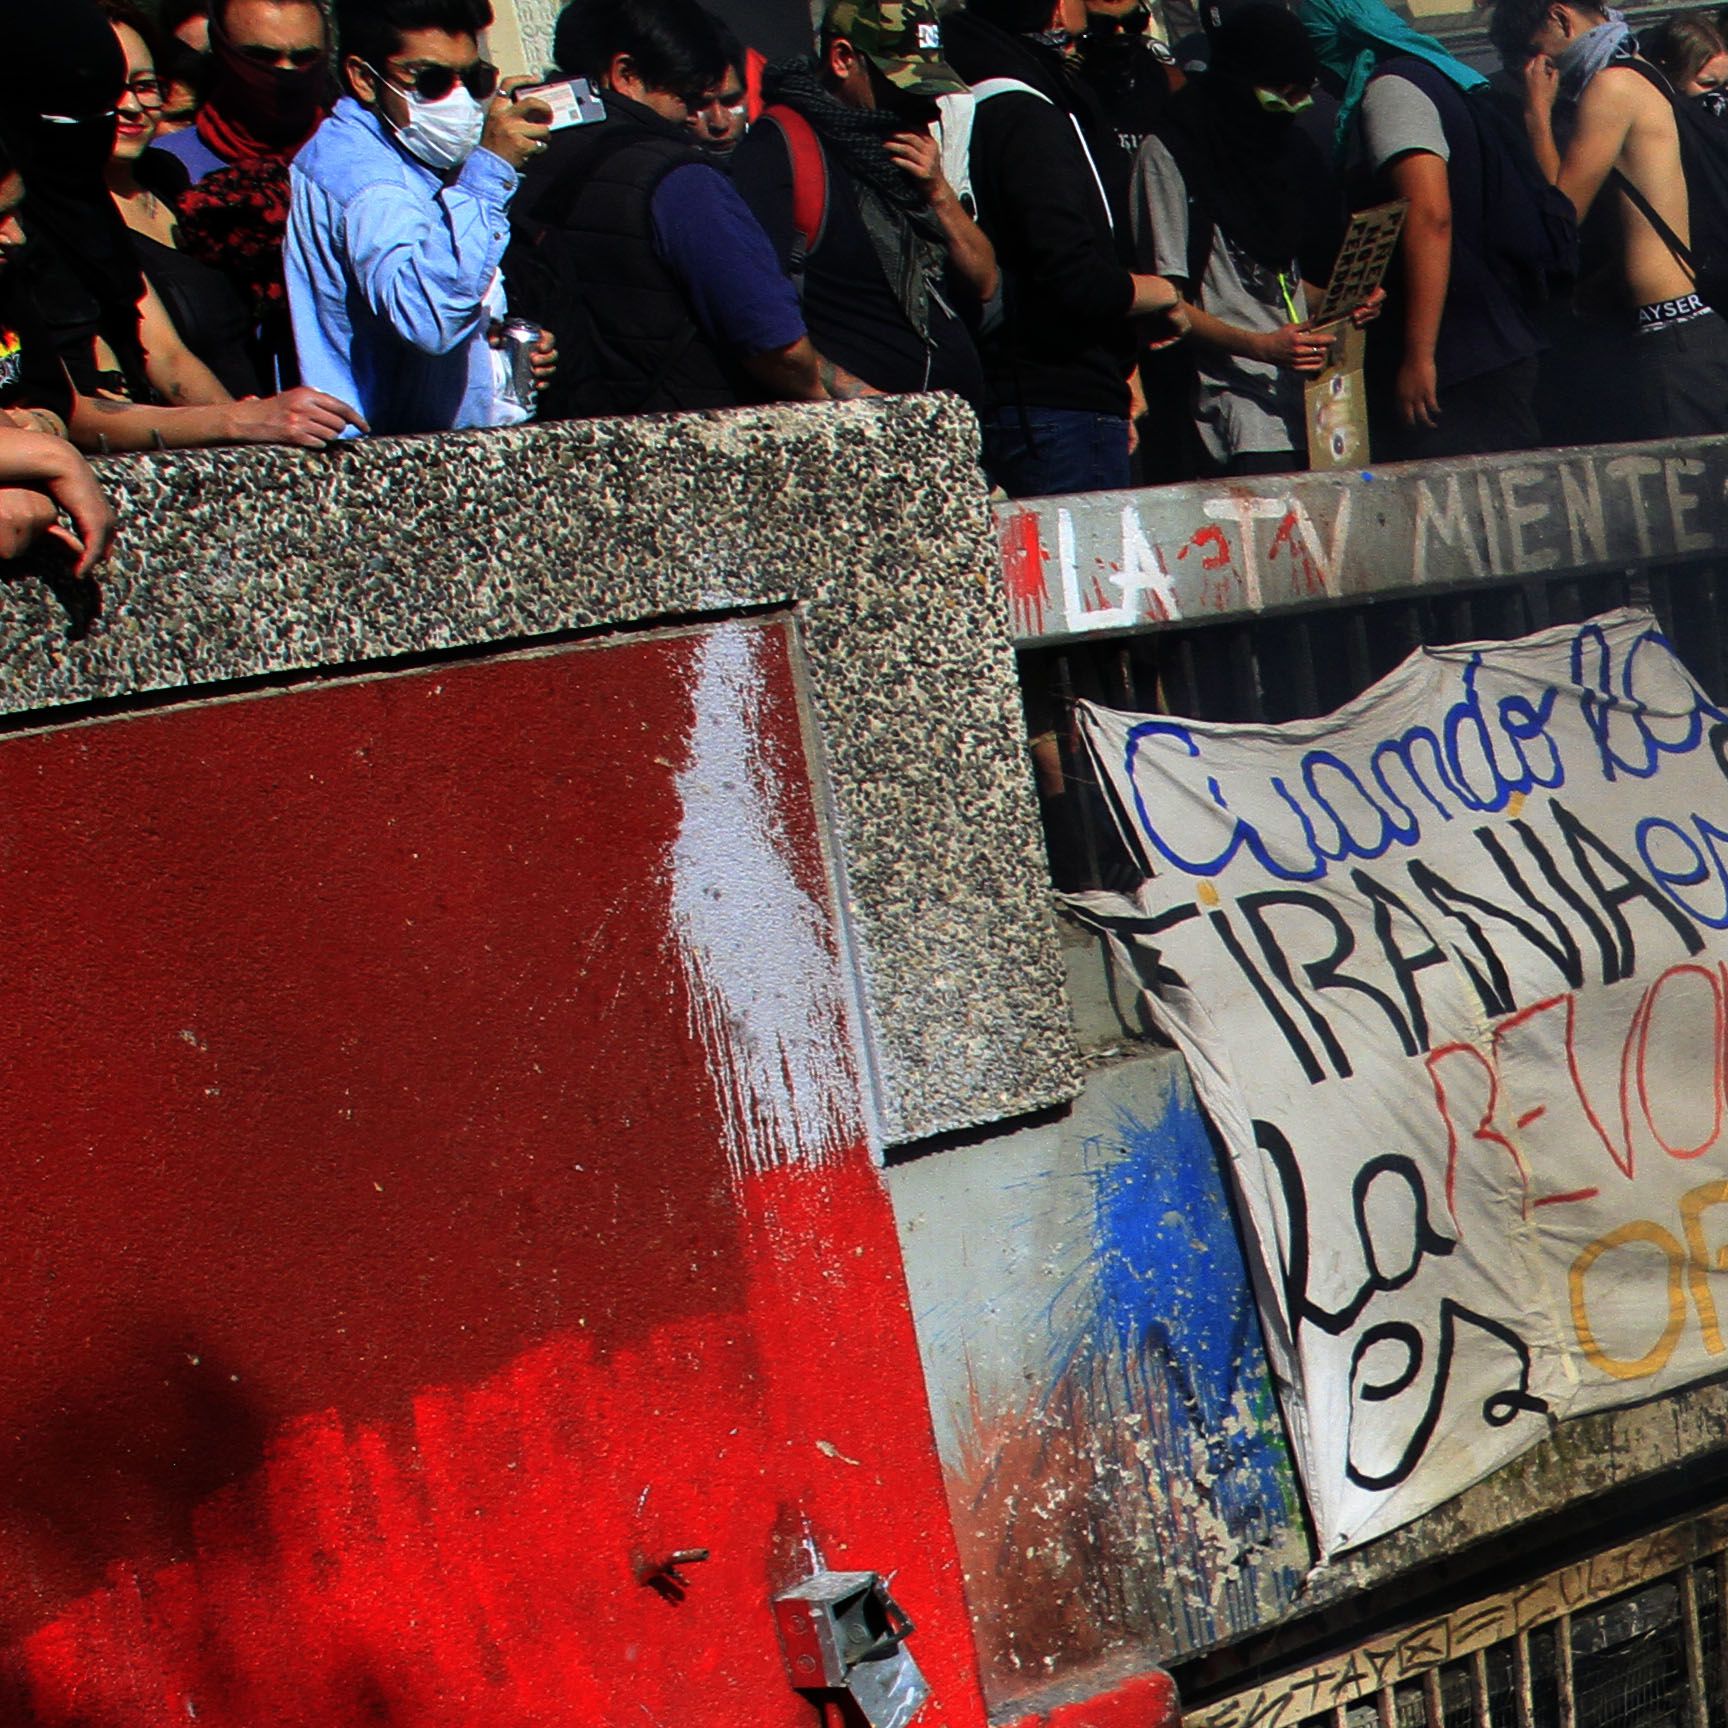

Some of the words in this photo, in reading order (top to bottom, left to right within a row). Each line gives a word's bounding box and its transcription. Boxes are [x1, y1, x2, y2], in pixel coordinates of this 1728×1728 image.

[1638, 293, 1704, 324] AYSER
[1056, 503, 1182, 636] LA
[1411, 453, 1711, 586] MIENTE
[1122, 653, 1568, 882] Cuando
